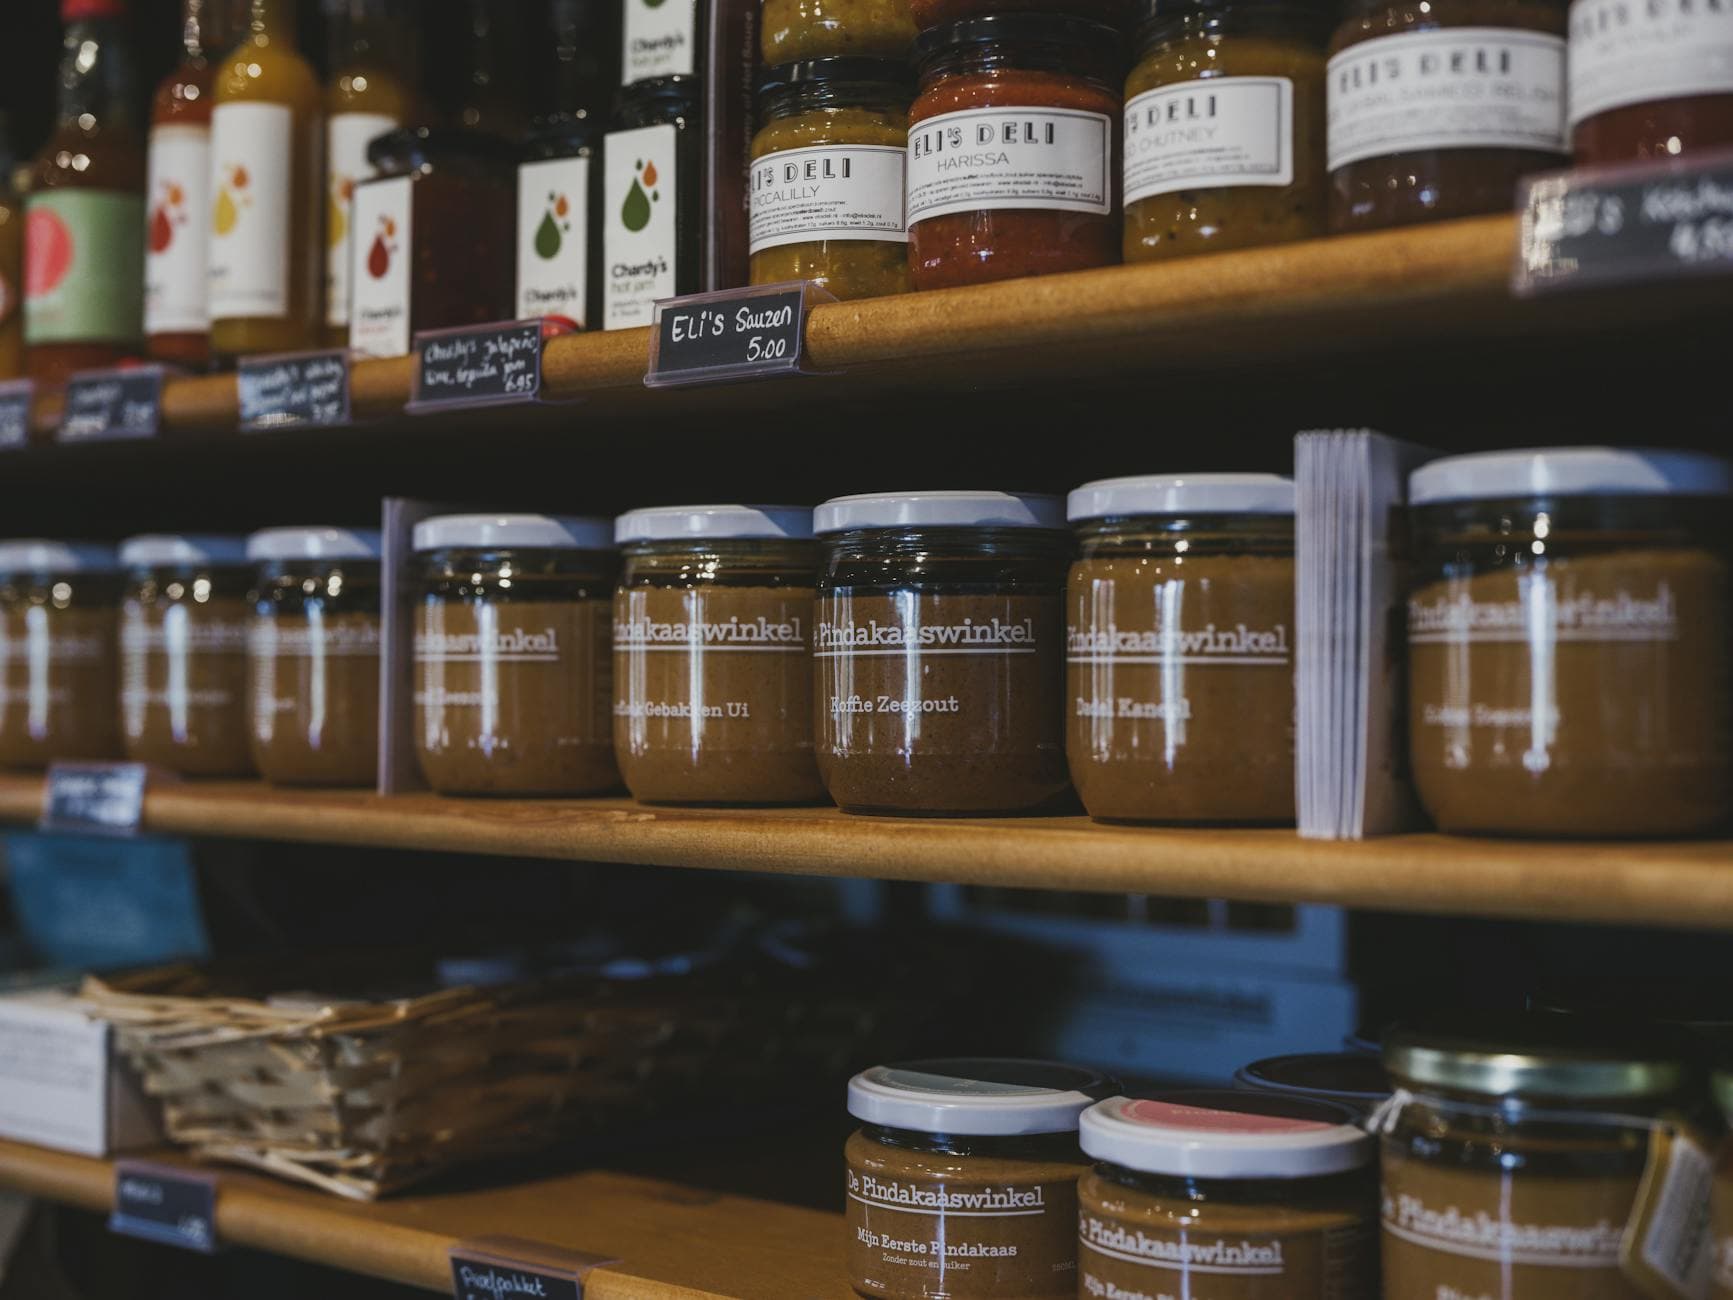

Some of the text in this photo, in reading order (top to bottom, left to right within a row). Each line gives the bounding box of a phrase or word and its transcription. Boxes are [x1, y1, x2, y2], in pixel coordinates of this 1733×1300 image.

[1420, 48, 1511, 76] DELI
[1147, 94, 1216, 126] DELI
[913, 121, 1054, 160] ELI'S DELI
[1139, 126, 1217, 153] CHUTNEY
[783, 157, 851, 184] DELI
[937, 152, 1010, 173] HARISSA
[735, 305, 792, 333] Sauzen
[819, 618, 1036, 648] Pindakaaswinkel
[726, 702, 750, 718] Ui
[829, 695, 960, 714] Koffie Zeezout
[862, 1175, 1046, 1210] Pindakaaswinkel
[857, 1226, 1018, 1257] Mijn Eerste Pindakaas
[1089, 1217, 1285, 1265] Pindakaaswinkel
[882, 1251, 972, 1271] Zonder zout en uiker
